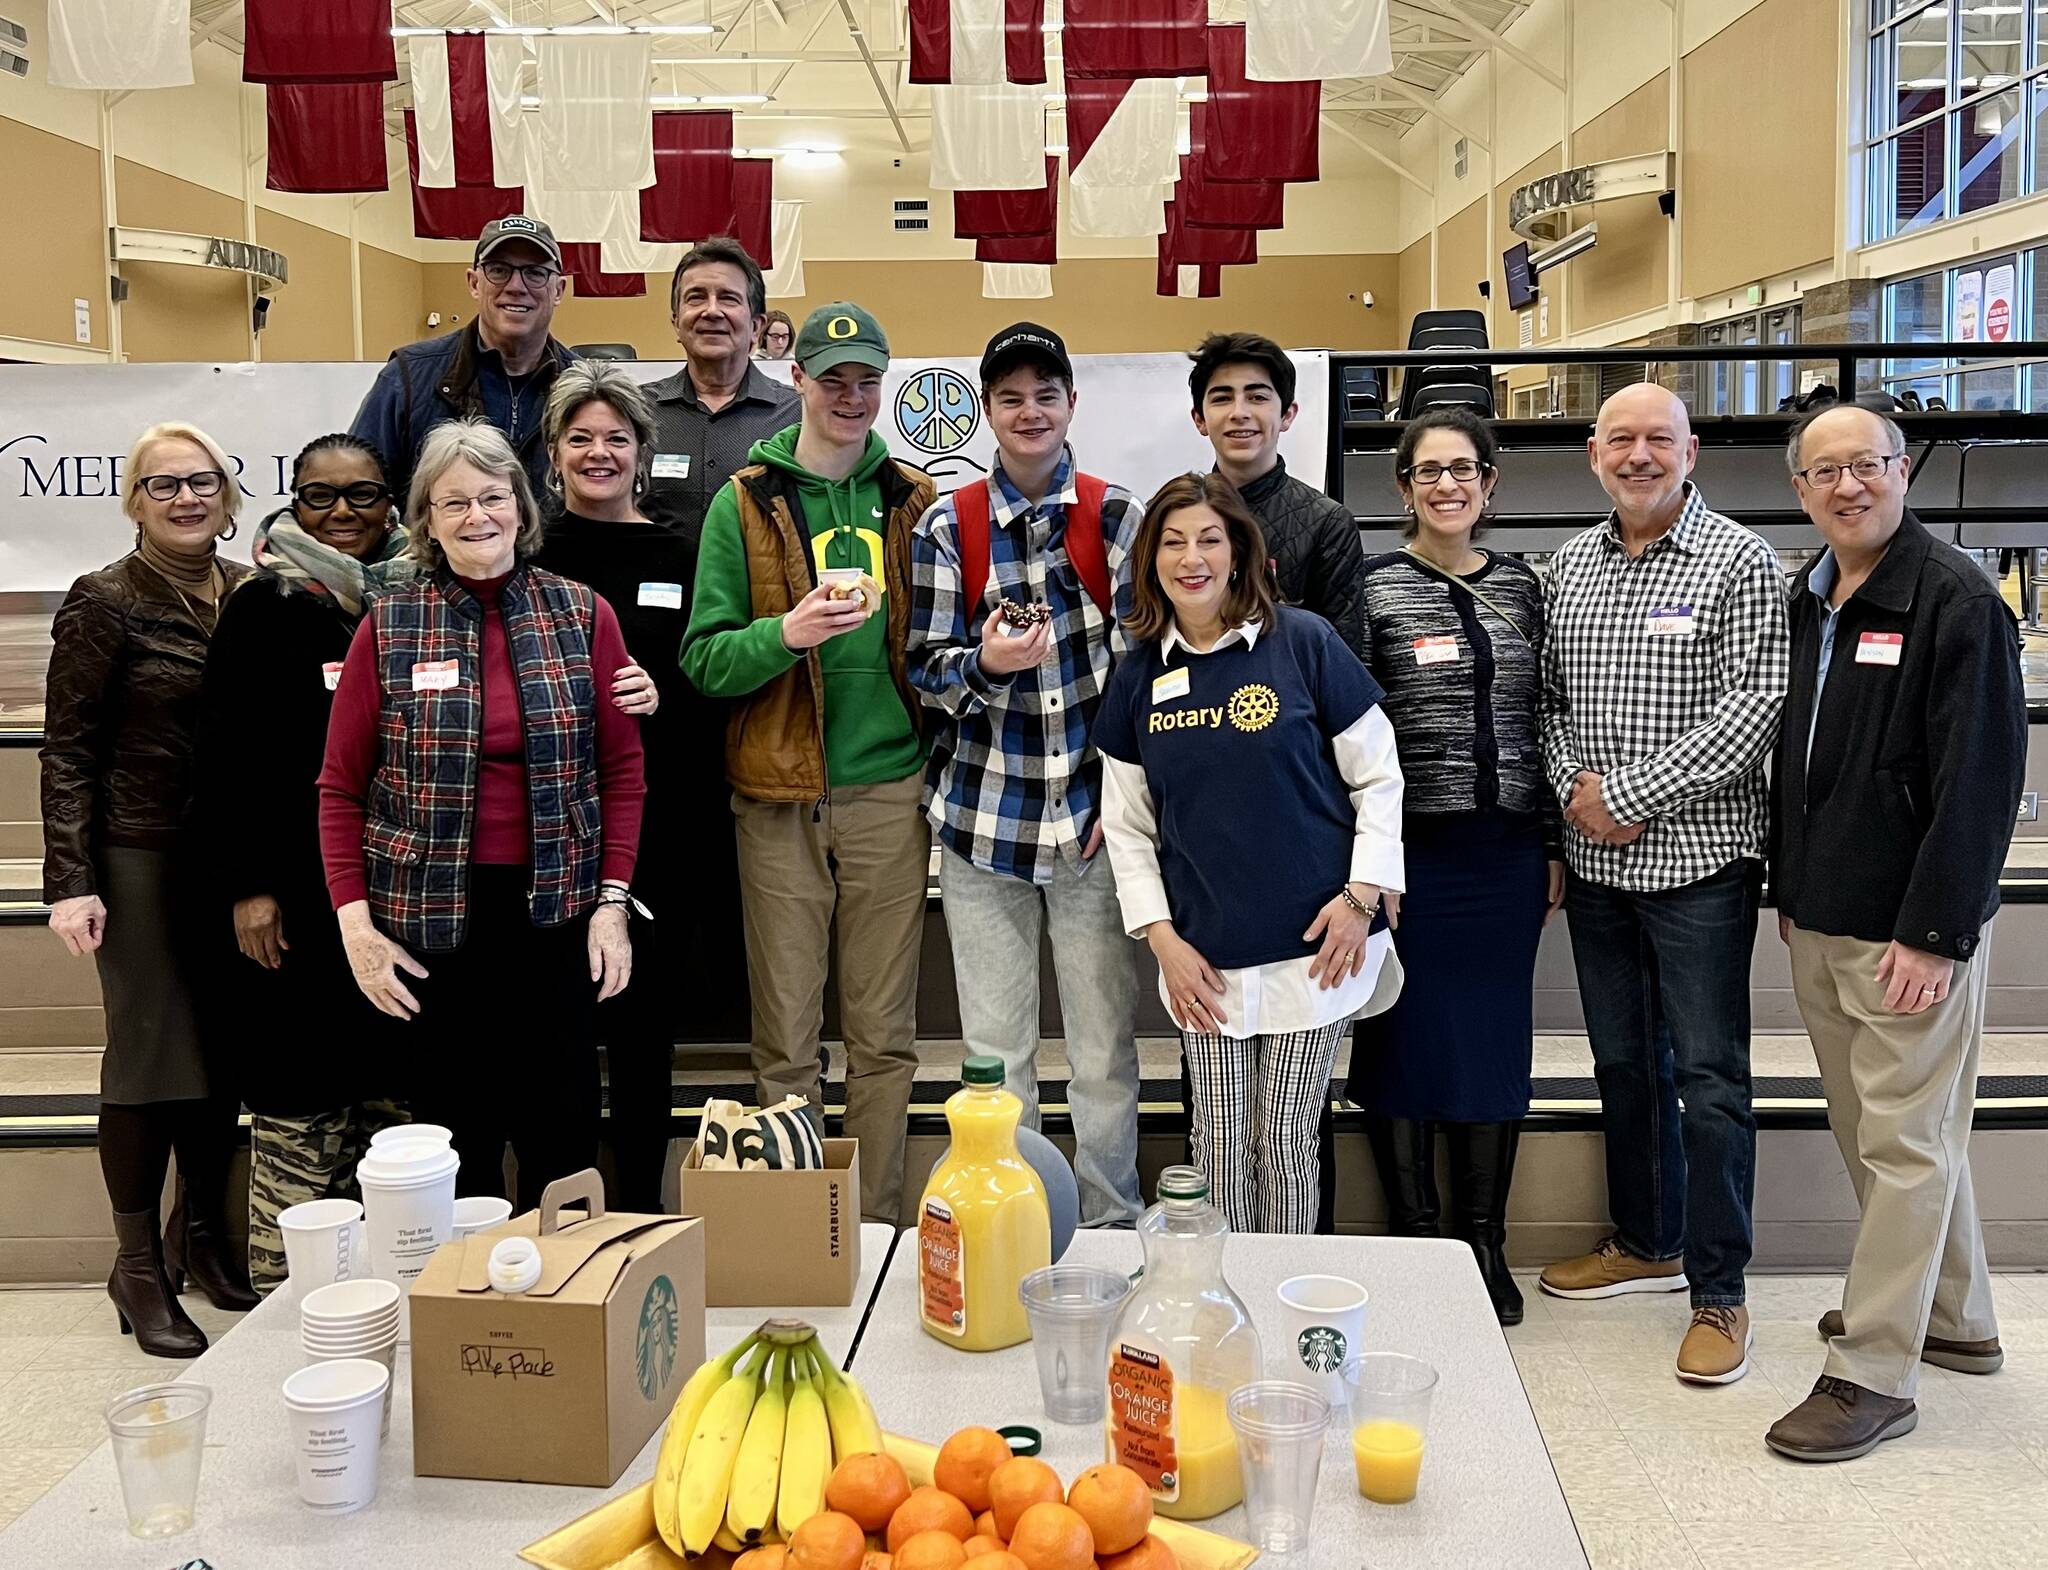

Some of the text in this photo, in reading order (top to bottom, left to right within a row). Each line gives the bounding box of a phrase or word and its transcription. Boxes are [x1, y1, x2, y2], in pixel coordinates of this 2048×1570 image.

[1149, 706, 1224, 734] Rotary
[829, 1182, 840, 1258] STARBUCKS
[921, 1235, 959, 1262] ORANGE
[929, 1251, 951, 1271] JUICE
[1122, 1346, 1159, 1364] KIRKLAND
[1112, 1362, 1170, 1395] ORGANIC
[1113, 1382, 1169, 1415] ORANGE
[1126, 1401, 1158, 1427] JUICE
